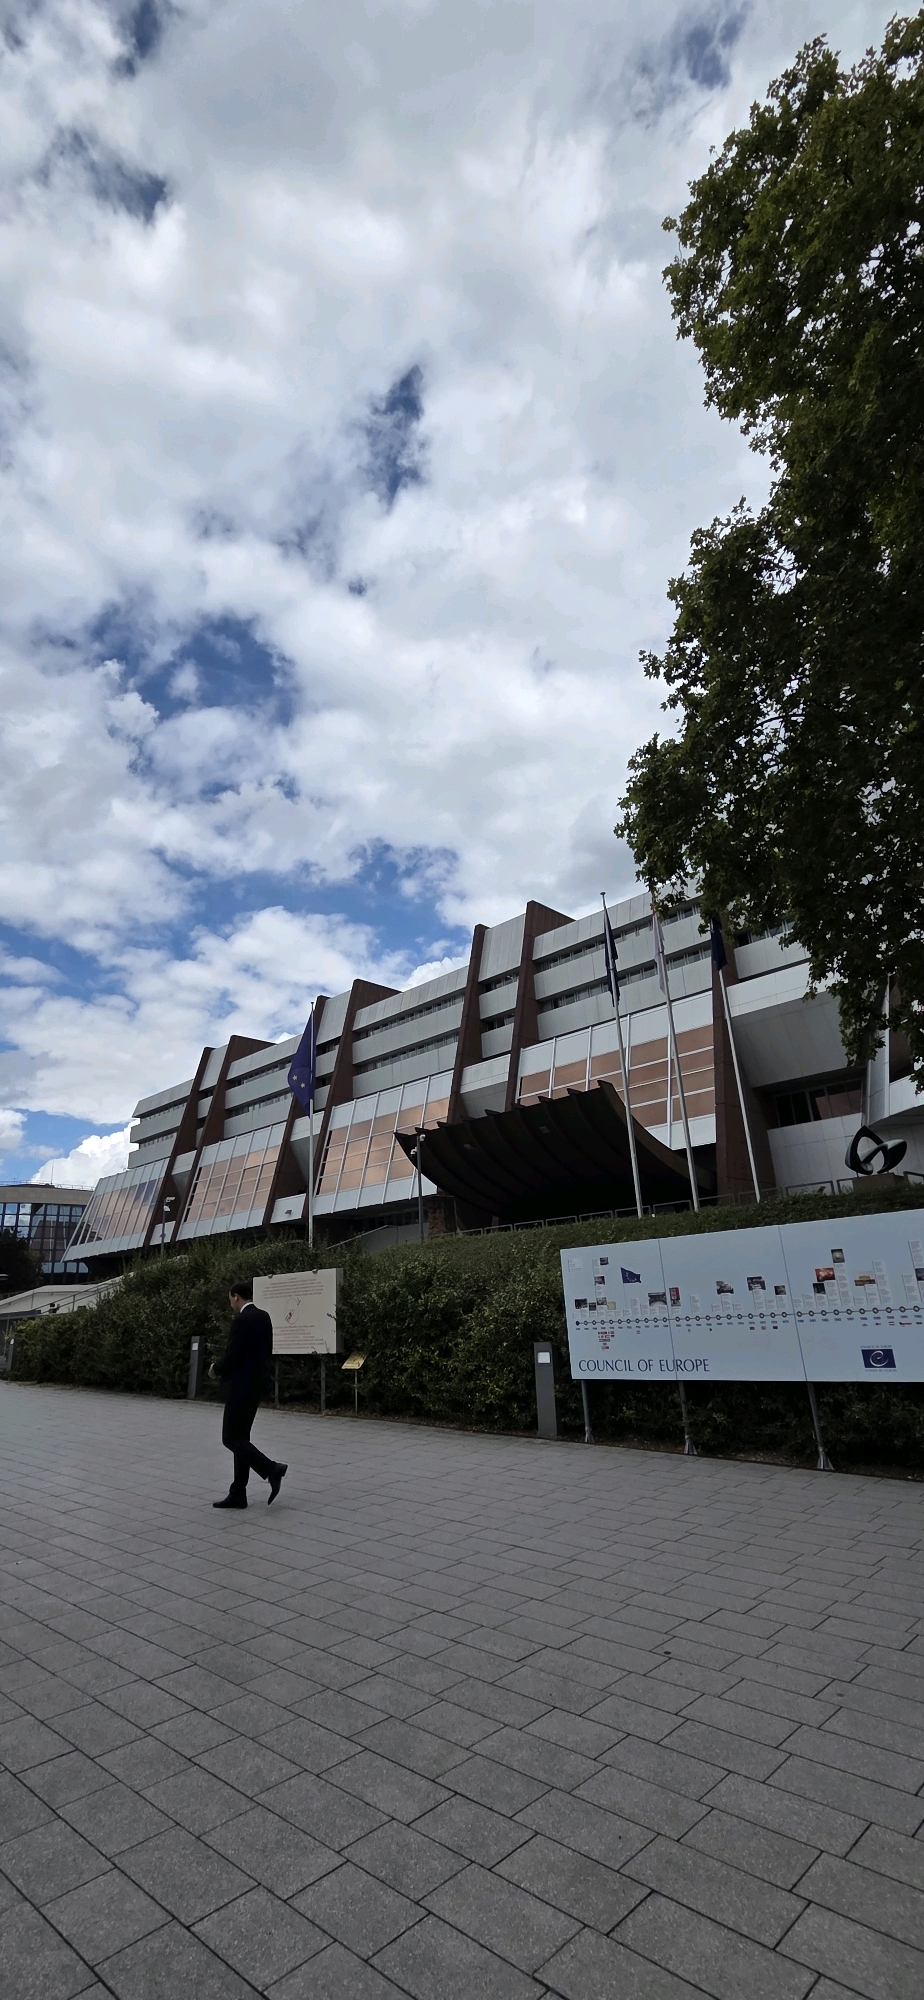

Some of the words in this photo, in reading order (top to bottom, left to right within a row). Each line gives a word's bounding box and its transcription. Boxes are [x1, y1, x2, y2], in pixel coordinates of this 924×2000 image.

[578, 1359, 634, 1372] COUNCIL
[637, 1359, 654, 1372] OF
[659, 1358, 710, 1372] EUROPE
